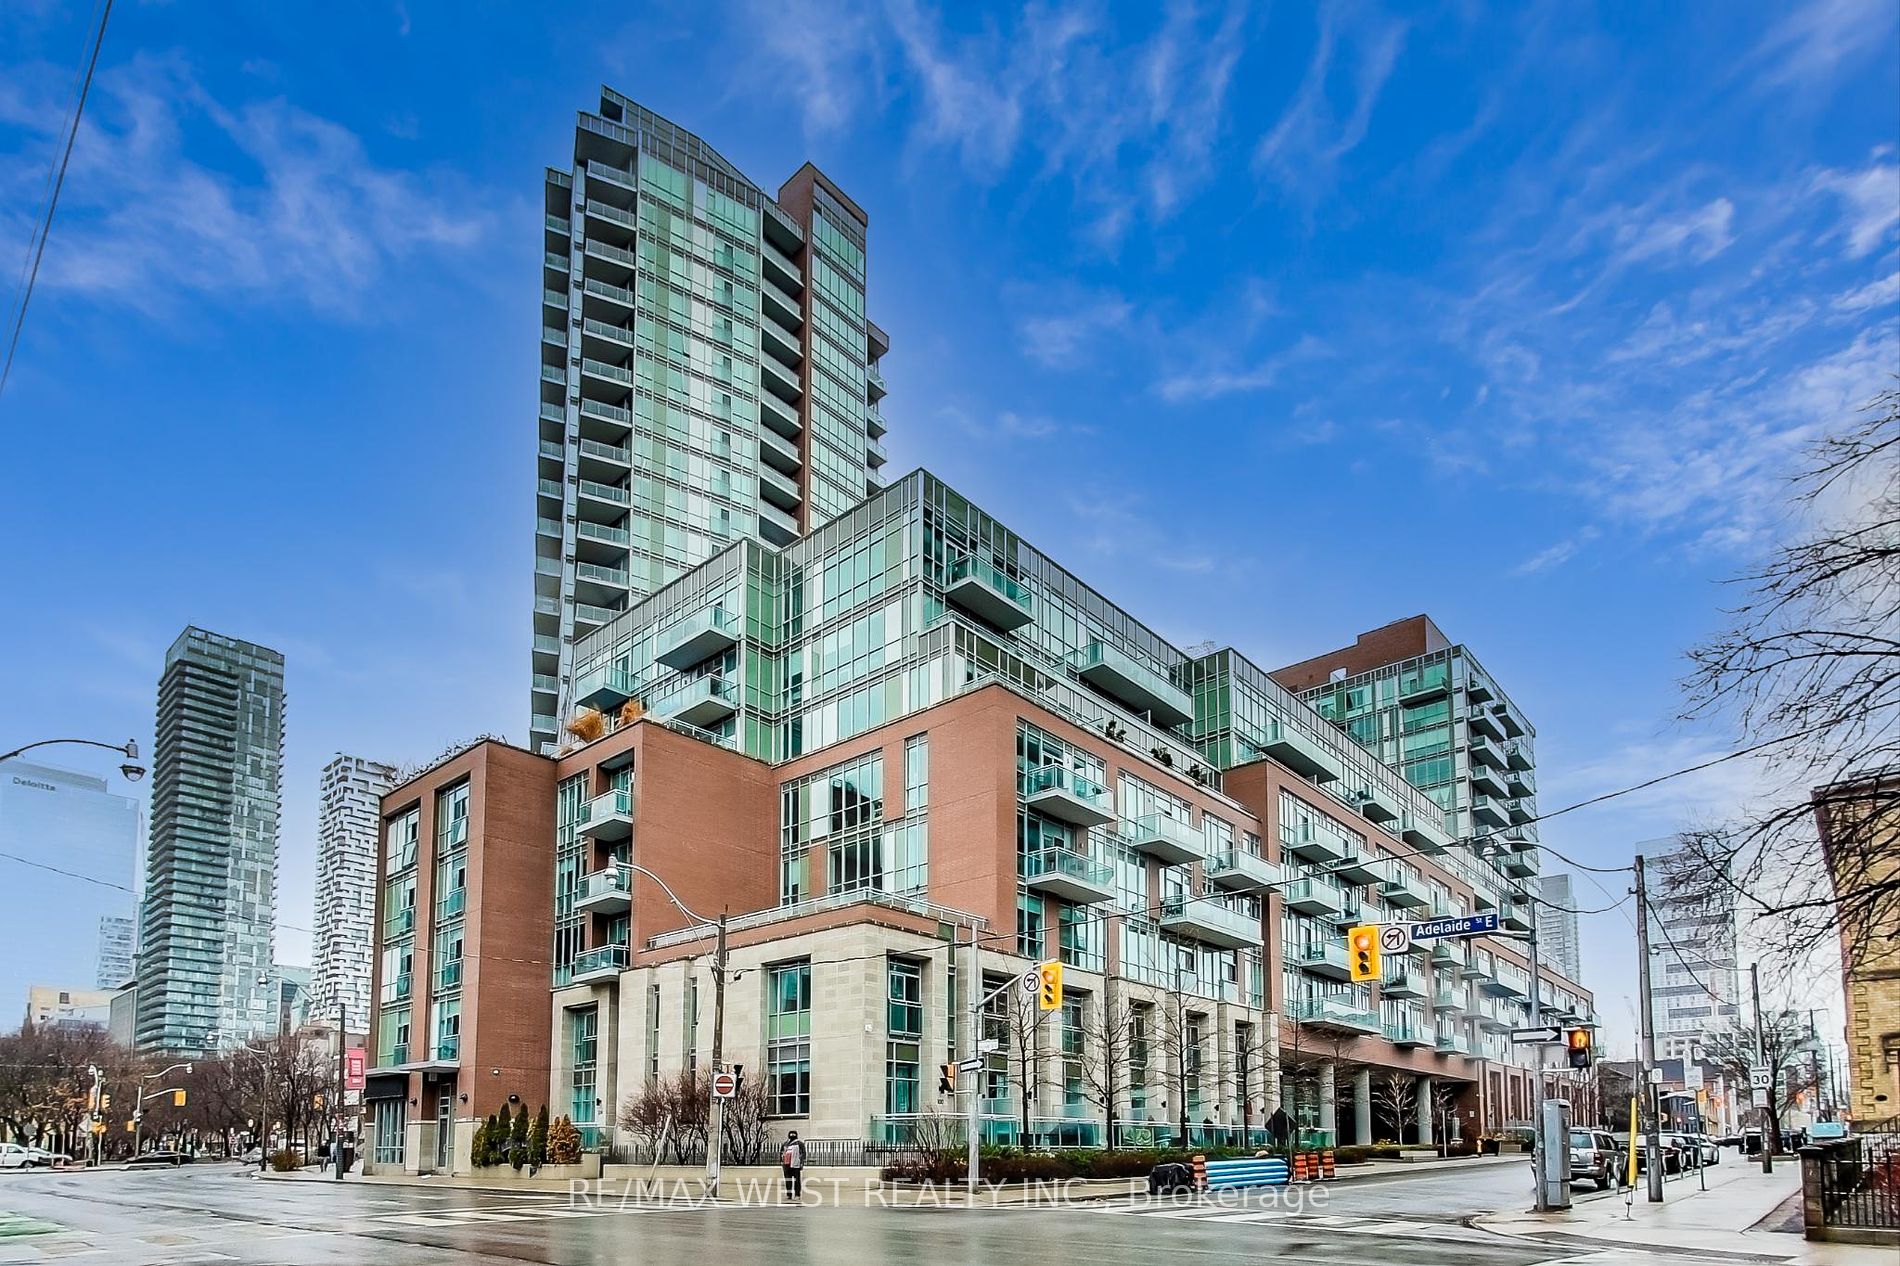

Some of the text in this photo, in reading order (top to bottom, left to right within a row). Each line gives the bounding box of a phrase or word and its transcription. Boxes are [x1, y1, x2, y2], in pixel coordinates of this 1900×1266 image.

[12, 776, 56, 791] Deloitte
[1416, 920, 1471, 937] Adelaide
[1485, 915, 1493, 928] E
[1752, 1074, 1769, 1085] 30
